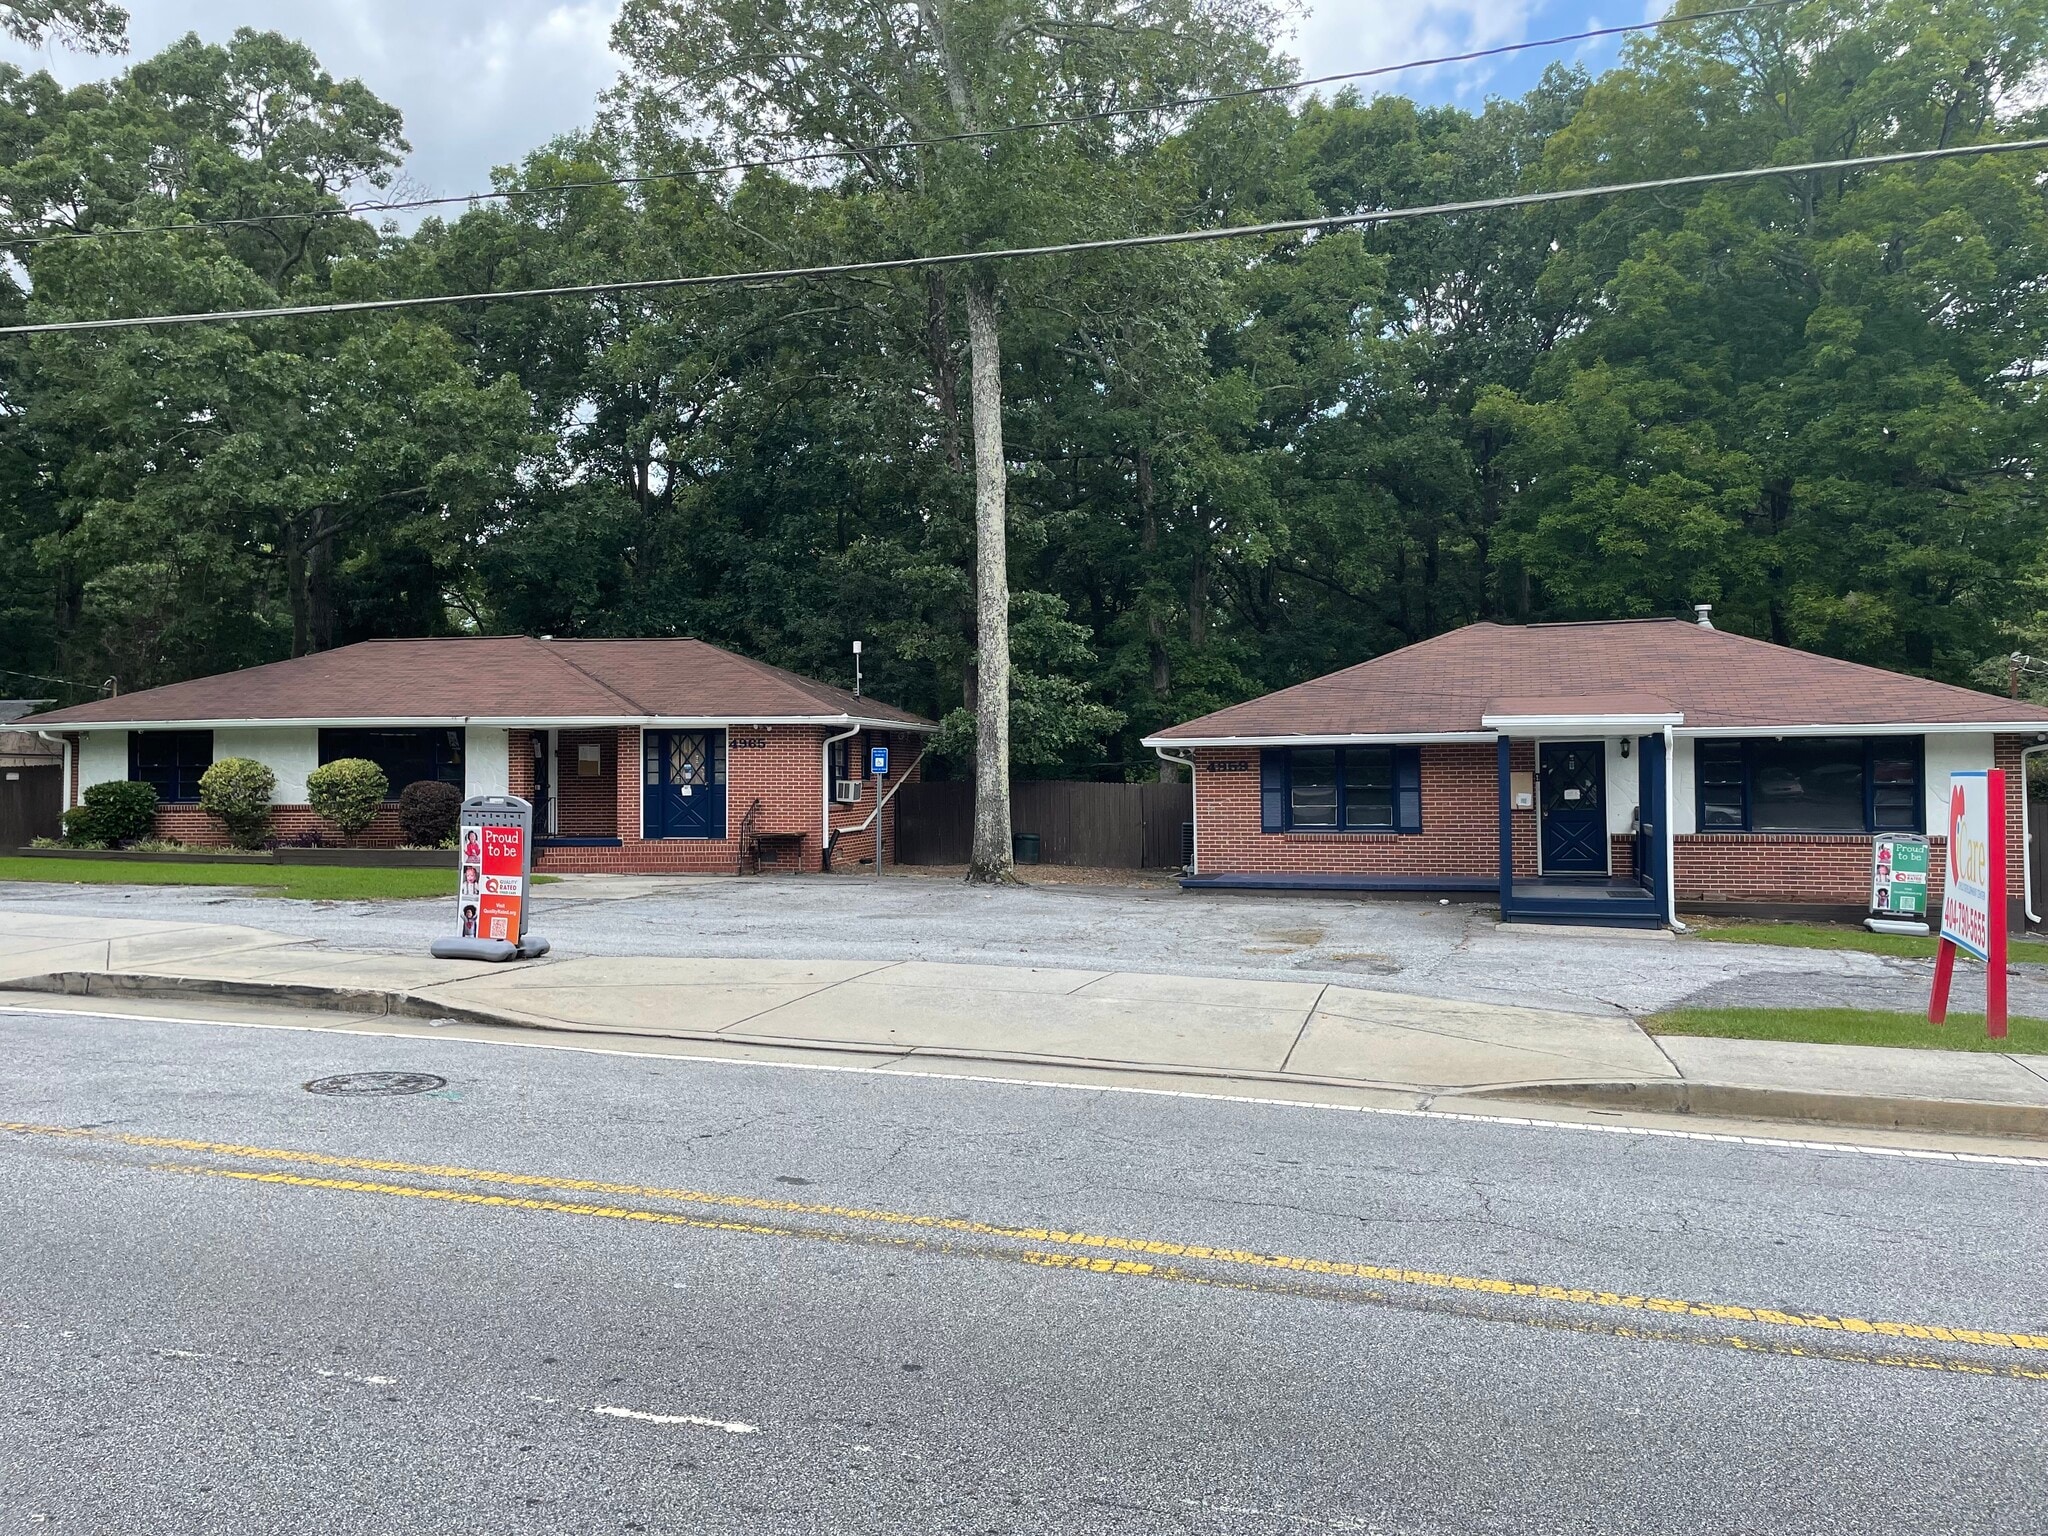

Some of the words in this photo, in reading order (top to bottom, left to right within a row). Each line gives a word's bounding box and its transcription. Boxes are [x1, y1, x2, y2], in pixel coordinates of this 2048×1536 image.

[729, 738, 766, 749] 4965
[485, 830, 518, 844] Proud
[488, 843, 500, 856] to
[503, 844, 517, 857] be
[1896, 843, 1924, 853] Proud
[1898, 852, 1908, 860] to
[1911, 852, 1922, 861] be
